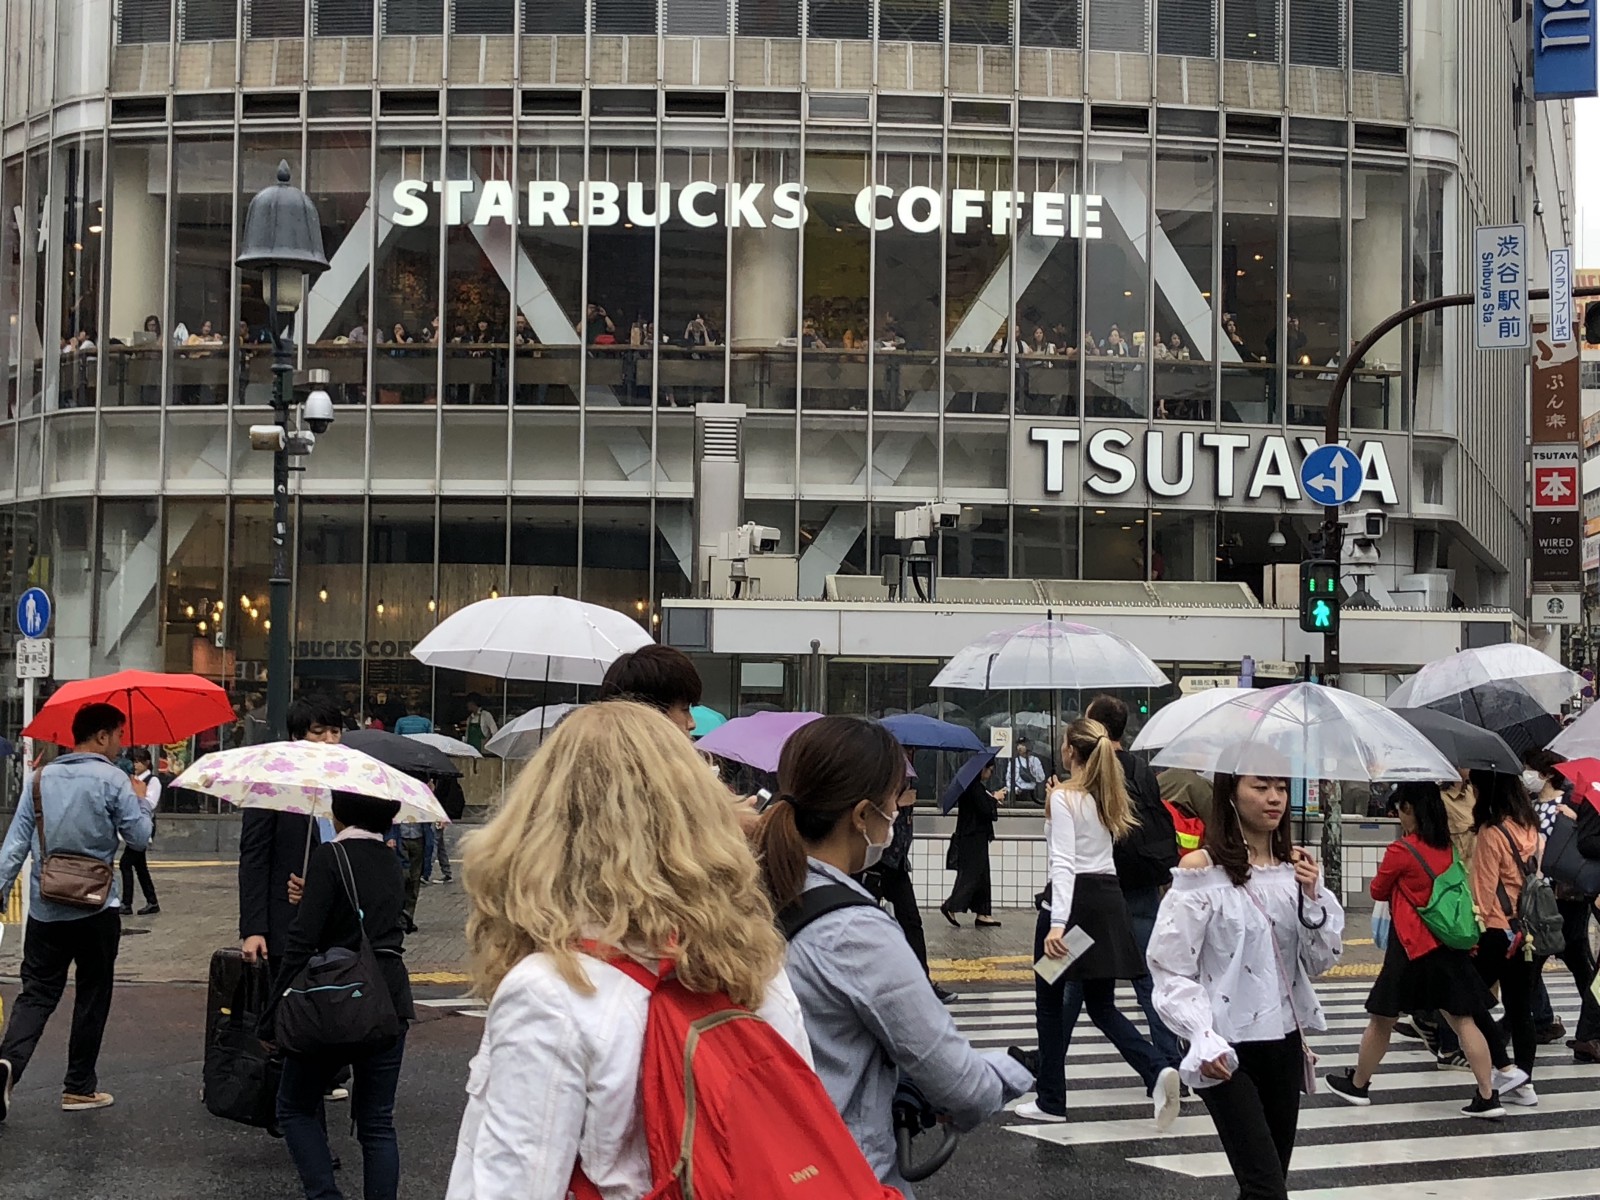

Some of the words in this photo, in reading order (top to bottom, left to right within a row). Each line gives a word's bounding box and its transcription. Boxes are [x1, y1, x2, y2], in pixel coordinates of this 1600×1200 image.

[391, 179, 809, 229] STARBUCKS
[854, 184, 1103, 239] COFFEE
[1480, 251, 1494, 299] Shibuya
[1497, 234, 1521, 338] 渋谷駅前
[1482, 303, 1495, 327] Sta.
[1533, 452, 1579, 460] TSUTAYA
[1540, 471, 1572, 502] 本
[1539, 538, 1574, 547] WIRED
[1543, 547, 1570, 555] TOKYO
